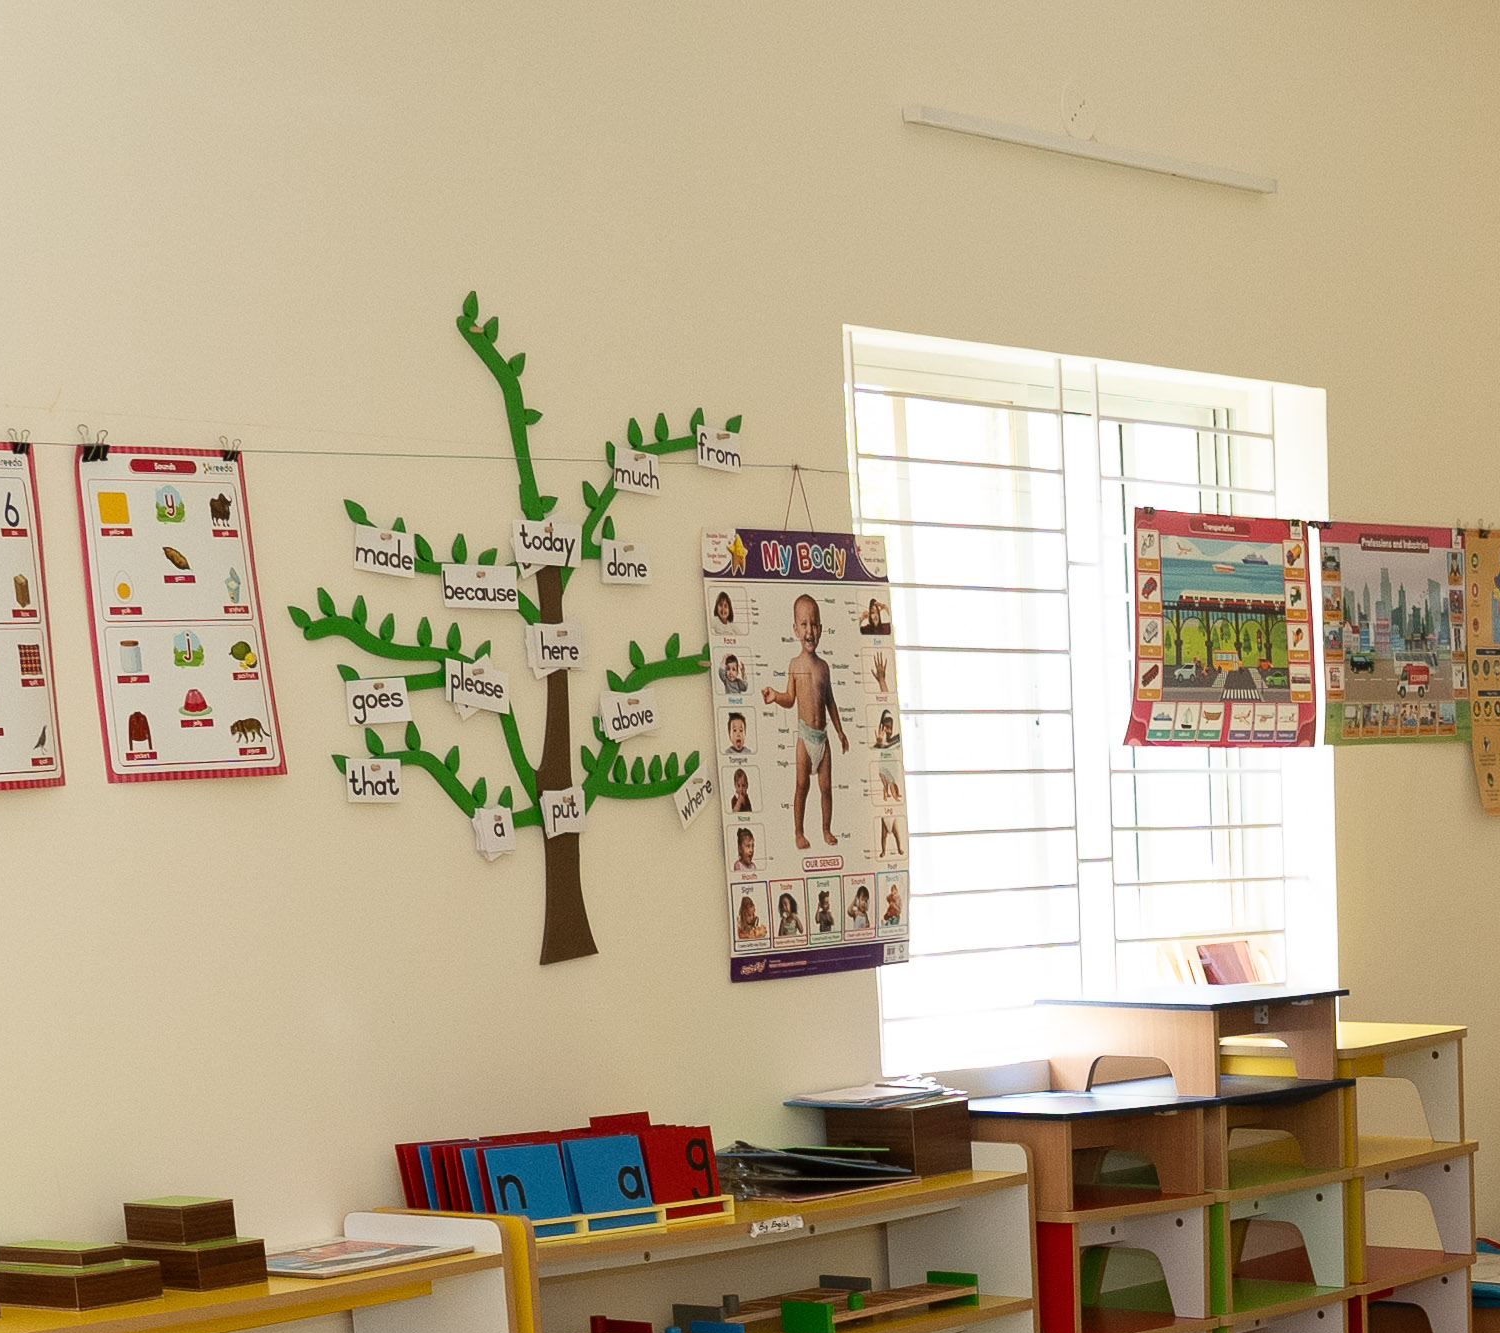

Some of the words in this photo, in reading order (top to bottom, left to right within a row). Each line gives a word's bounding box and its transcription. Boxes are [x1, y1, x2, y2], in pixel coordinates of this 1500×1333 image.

[698, 433, 741, 467] from
[154, 462, 176, 471] Sounds
[208, 463, 233, 473] kreedo
[615, 461, 659, 490] much
[4, 491, 20, 527] 6
[164, 494, 175, 517] y
[356, 539, 413, 570] made
[521, 522, 575, 566] today
[1360, 537, 1391, 548] Professions
[1392, 540, 1402, 549] and
[1402, 540, 1429, 550] Industries
[607, 548, 647, 578] done
[761, 541, 792, 576] My
[796, 542, 846, 578] Body
[443, 570, 517, 602] because
[183, 633, 191, 661] j
[541, 631, 579, 661] here
[723, 637, 737, 645] Face
[450, 662, 504, 703] please
[353, 692, 404, 724] goes
[612, 701, 654, 732] above
[729, 756, 748, 765] Tongue
[349, 765, 400, 796] that
[552, 796, 580, 832] put
[680, 778, 713, 821] where
[494, 819, 506, 837] a
[805, 858, 818, 868] OUR
[819, 858, 840, 867] SENSES
[741, 886, 754, 894] Sight
[780, 883, 792, 891] Taste
[617, 1165, 646, 1201] a
[685, 1137, 714, 1198] g
[496, 1174, 528, 1211] n
